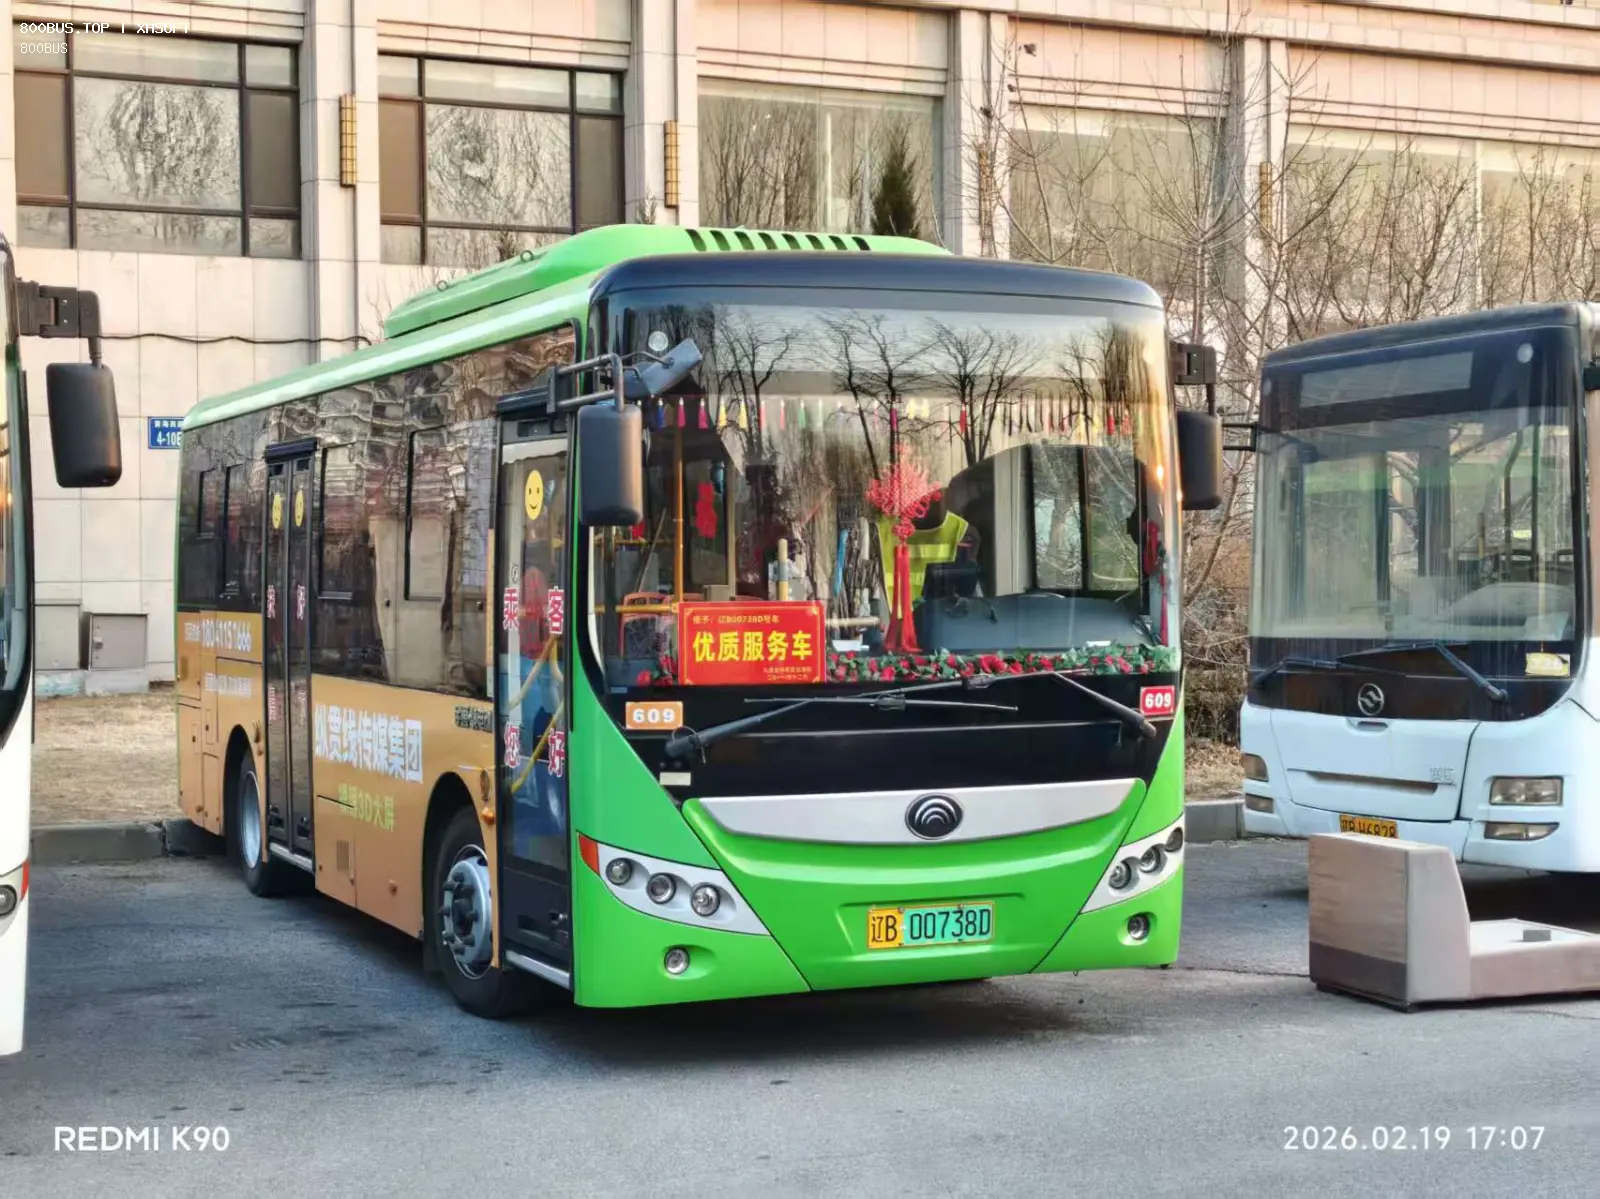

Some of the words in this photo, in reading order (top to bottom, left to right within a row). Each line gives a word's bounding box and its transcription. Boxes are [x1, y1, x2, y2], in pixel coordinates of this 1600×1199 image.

[548, 585, 565, 634] 客
[692, 630, 813, 663] 优质服务车
[632, 708, 676, 724] 609
[1145, 692, 1172, 709] 609
[315, 703, 424, 784] 纵贯线传媒集团
[548, 727, 566, 779] 好
[909, 908, 992, 941] 00738D
